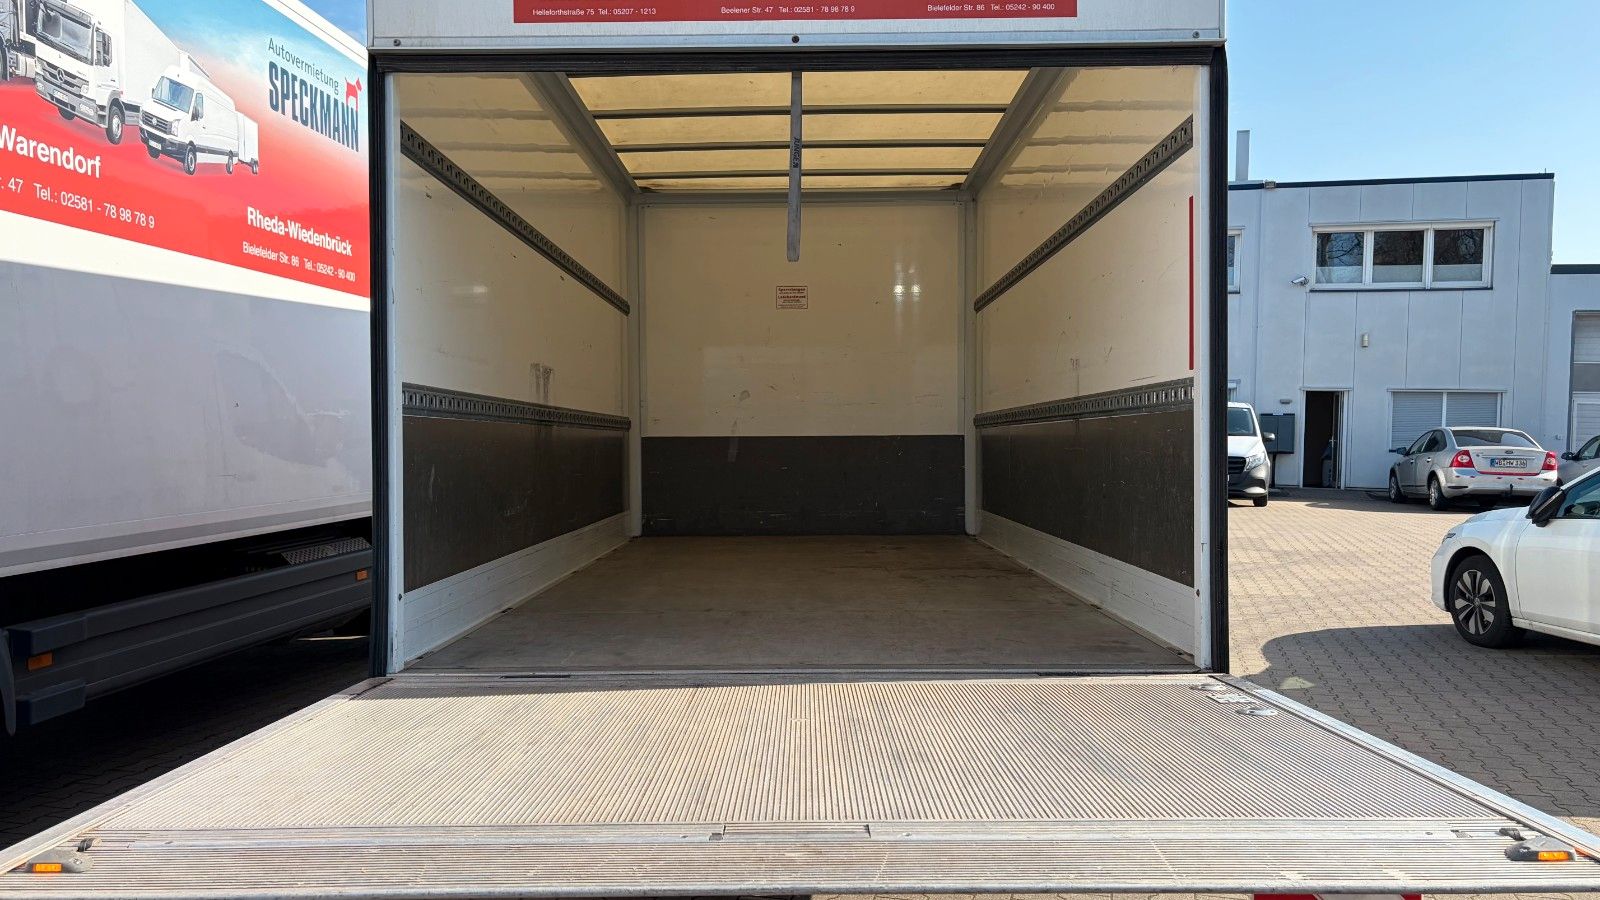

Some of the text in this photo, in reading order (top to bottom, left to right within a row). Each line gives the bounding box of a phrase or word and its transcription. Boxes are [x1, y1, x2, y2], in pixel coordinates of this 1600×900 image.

[586, 8, 595, 16] 75
[597, 8, 612, 16] Tel.:
[751, 6, 762, 14] Str.
[927, 4, 963, 12] Bielefelder
[963, 4, 975, 12] Str.
[268, 38, 339, 96] Autovermietung
[268, 60, 359, 153] SPECKMANN
[0, 124, 101, 179] Warendorf
[8, 177, 24, 193] 47
[33, 182, 59, 204] Tel.:
[60, 191, 93, 213] 02581
[103, 202, 117, 219] 78
[119, 207, 132, 223] 98
[134, 211, 147, 227] 78
[148, 215, 155, 229] 9
[247, 206, 353, 257] Rheda-Wiedenbrück
[242, 241, 278, 262] Bielefelder
[279, 252, 291, 265] Str.
[303, 258, 316, 272] Tel.:
[316, 262, 334, 277] 05242
